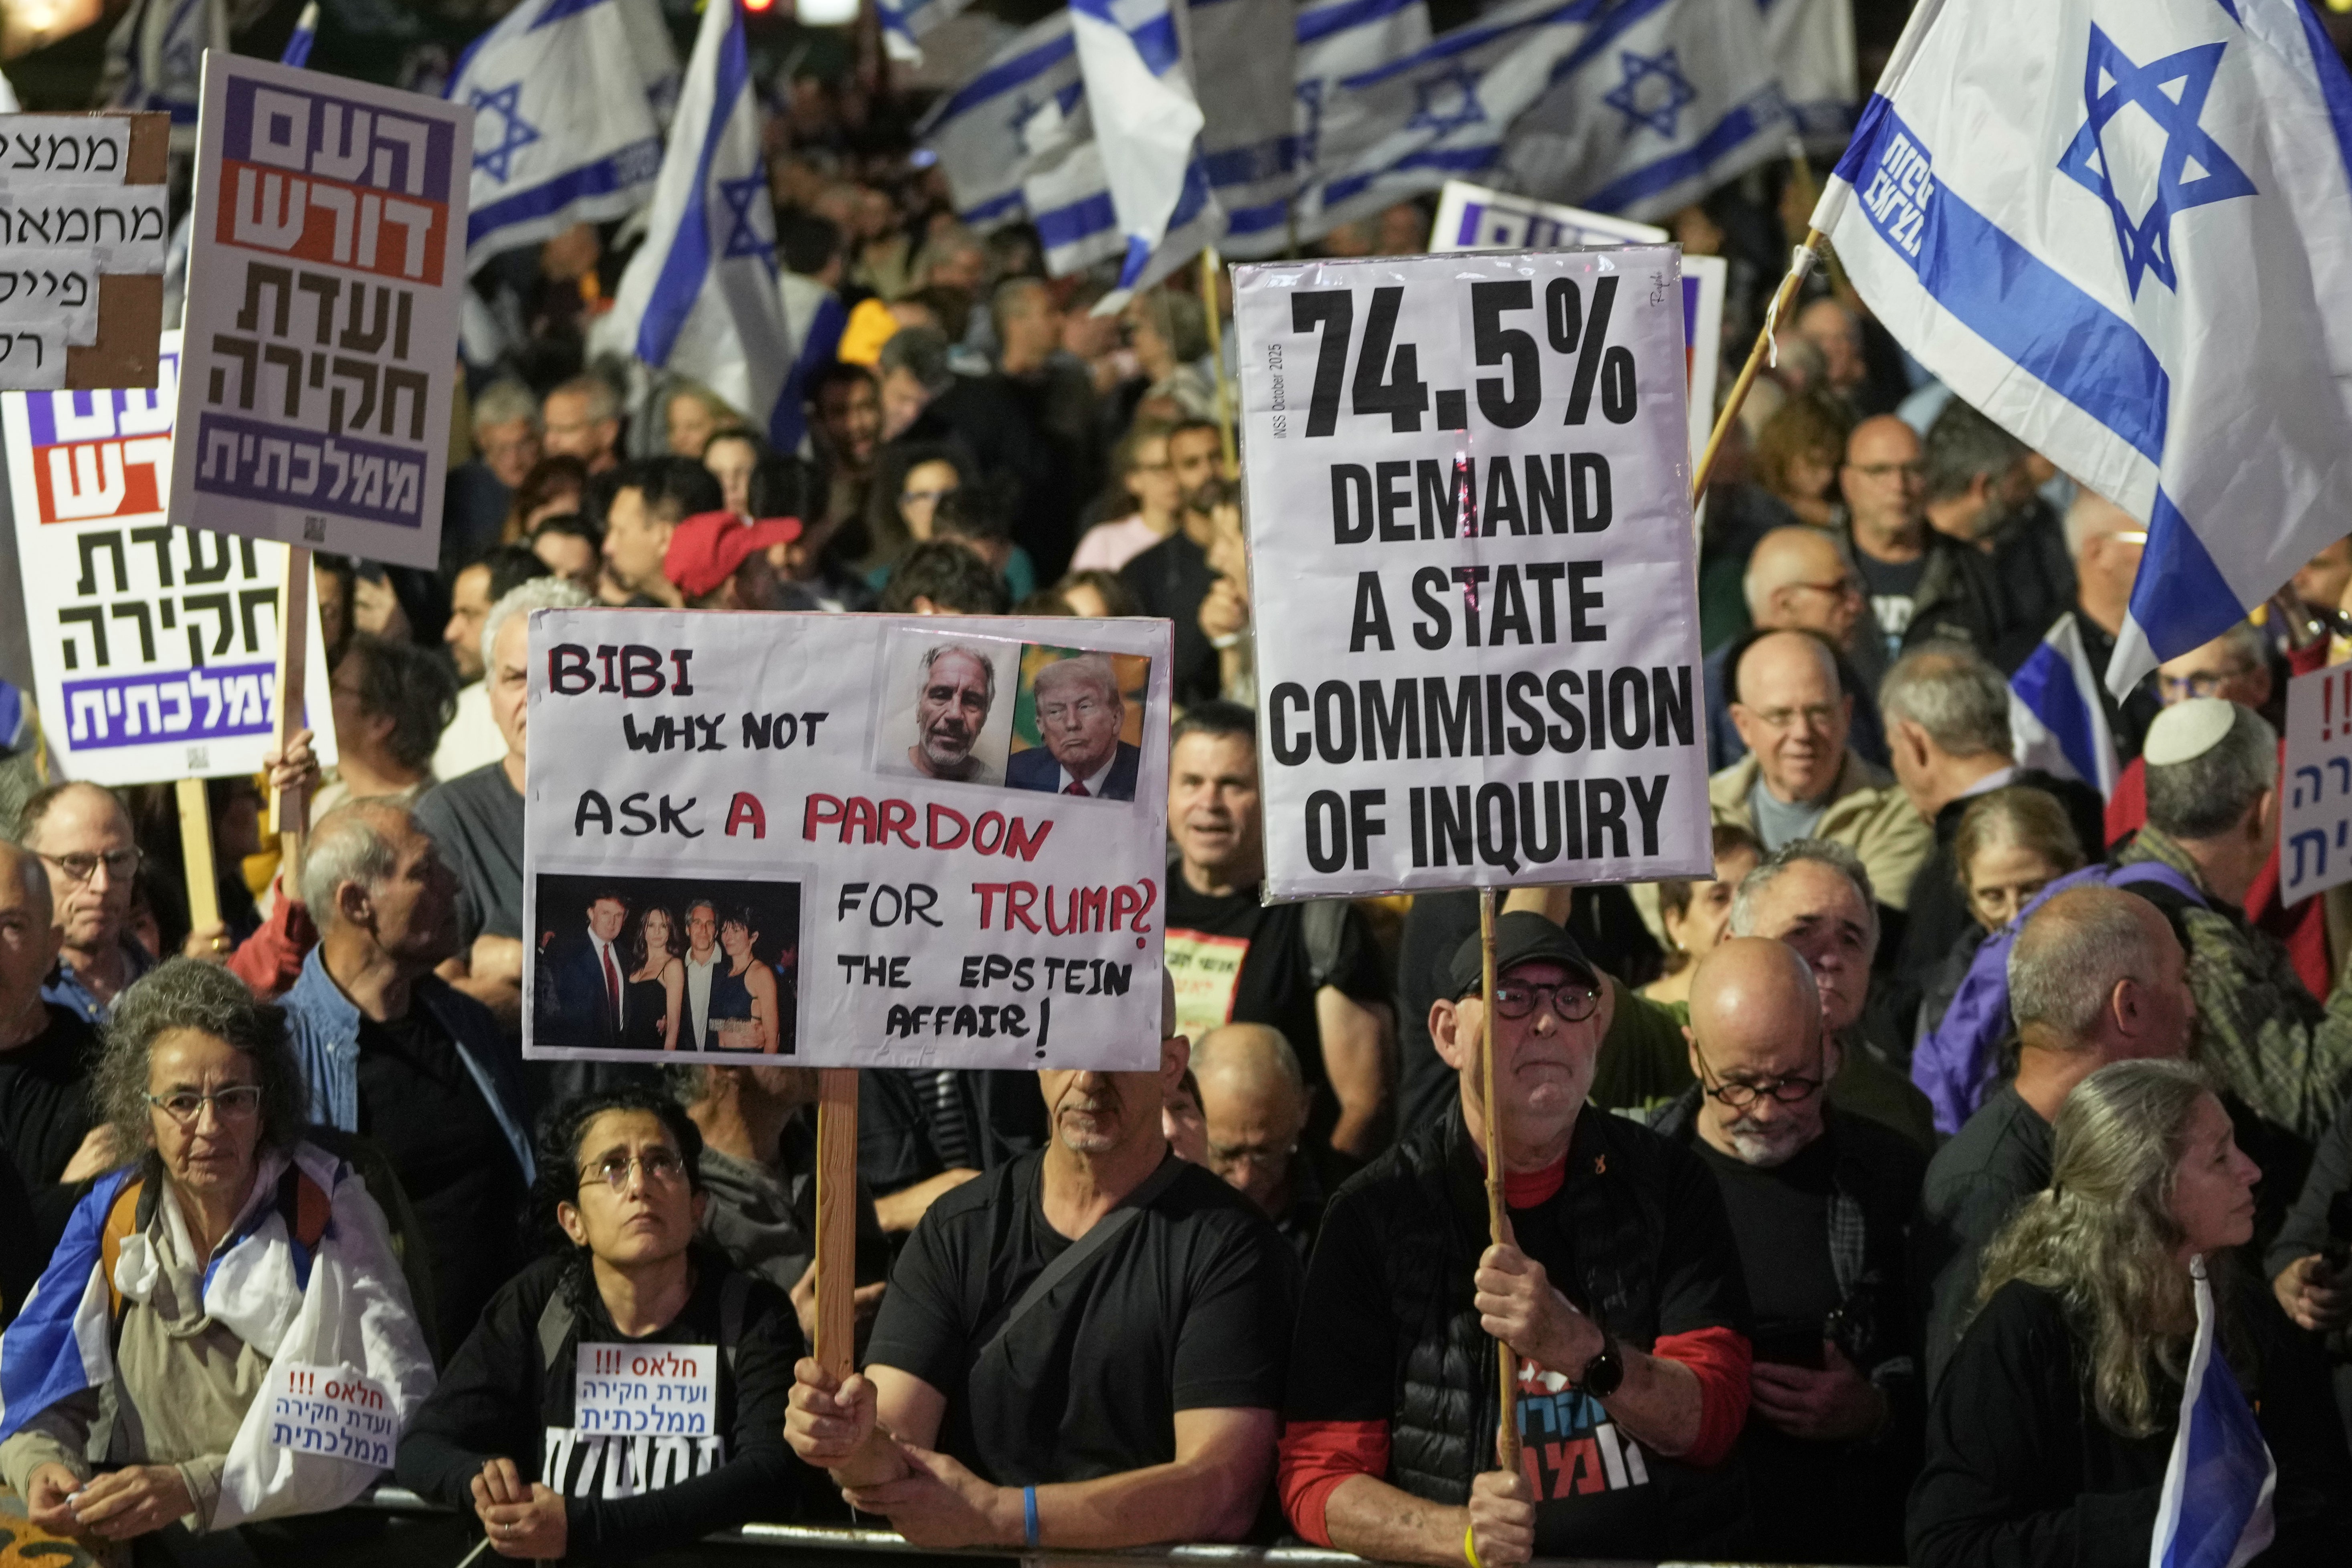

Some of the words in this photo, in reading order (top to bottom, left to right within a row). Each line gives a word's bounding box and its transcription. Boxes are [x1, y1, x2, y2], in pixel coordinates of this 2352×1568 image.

[250, 87, 429, 196] העם
[234, 168, 432, 278] דורש
[236, 261, 413, 360] ועדת
[1267, 343, 1283, 371] 2025
[1291, 275, 1637, 438] 74.5%
[208, 333, 429, 441] חקירה
[1270, 374, 1285, 411] October
[202, 428, 420, 514] ממלכתית
[1330, 452, 1612, 545] DEMAND
[77, 526, 258, 597] ועדת
[1350, 571, 1395, 652] A
[1412, 561, 1607, 651] STATE
[549, 644, 693, 698] BIBI
[623, 713, 727, 754] WHY
[742, 712, 829, 750] NOT
[1269, 666, 1695, 766] COMMISSION
[574, 790, 704, 839] ASK
[725, 791, 766, 839] A
[802, 792, 1054, 862] PARDON
[1305, 788, 1386, 874] OF
[1410, 774, 1670, 876] INQUIRY
[838, 882, 943, 927] FOR
[972, 878, 1157, 949] TRUMP?
[837, 954, 912, 988] THE
[959, 955, 1132, 996] EPSTEIN
[886, 998, 1051, 1059] AFFAIR!
[289, 1370, 315, 1396] !!!
[595, 1349, 621, 1375] !!!
[632, 1351, 697, 1378] חלאס
[276, 1397, 339, 1425] חקירה
[325, 1380, 383, 1410] חלאס
[581, 1403, 705, 1433] ממלכתית
[583, 1380, 648, 1405] חקירה
[657, 1383, 707, 1404] ועדת
[273, 1422, 388, 1465] ממלכתית
[346, 1408, 391, 1436] ועדת
